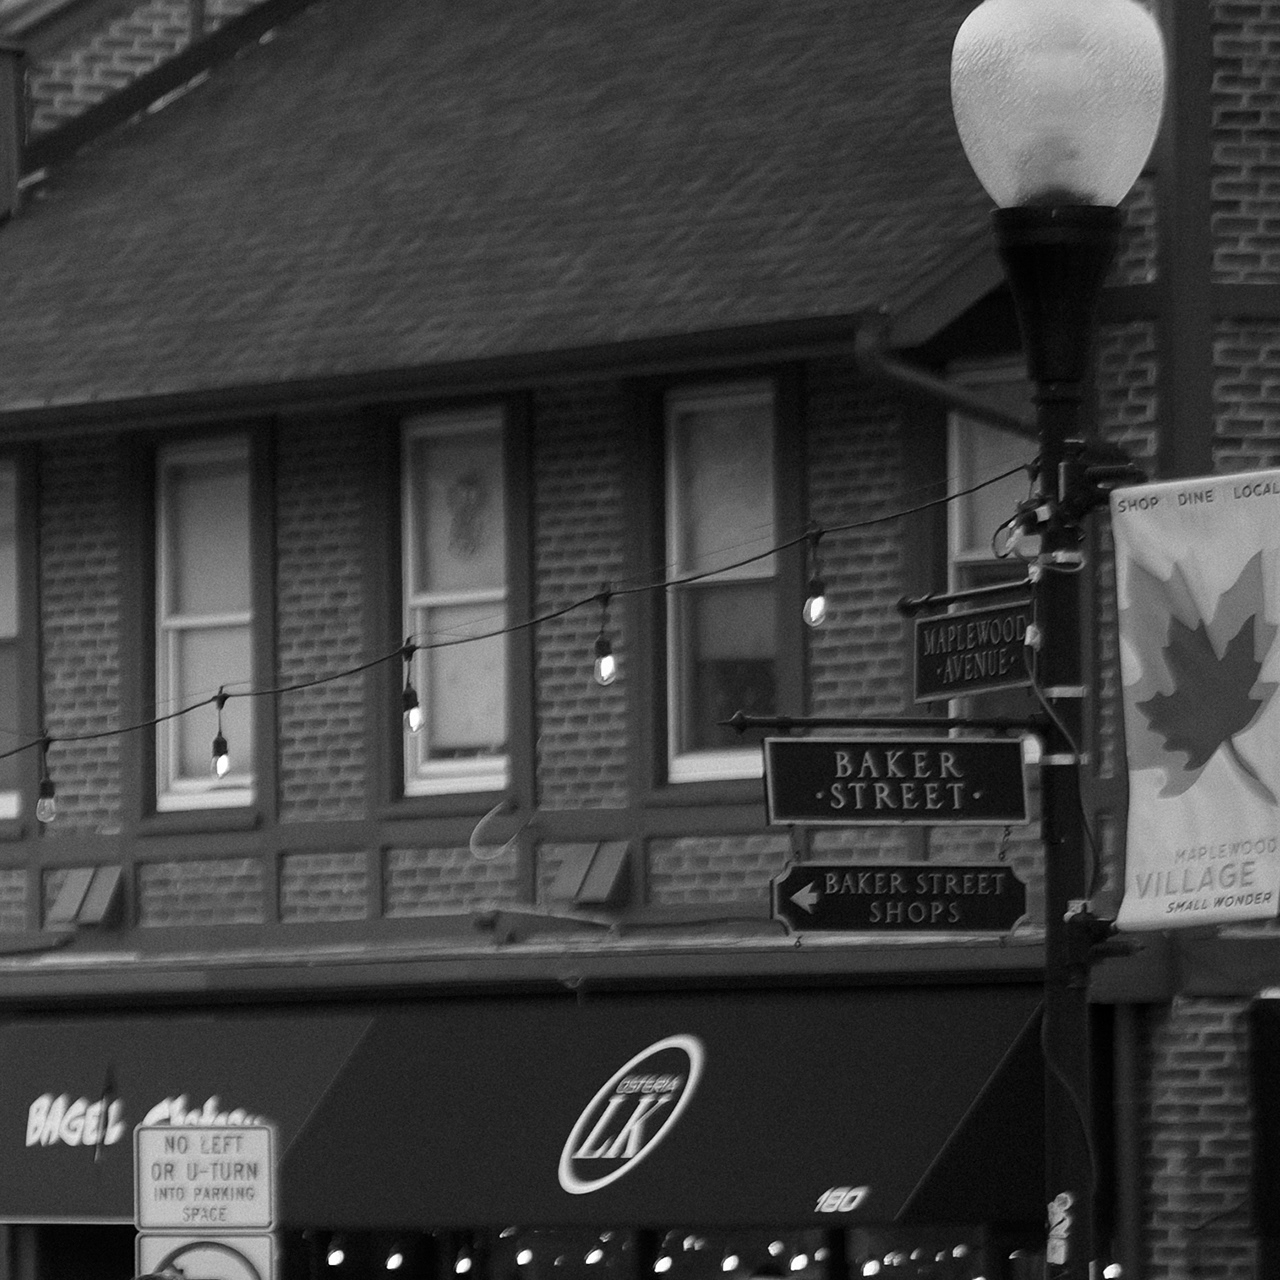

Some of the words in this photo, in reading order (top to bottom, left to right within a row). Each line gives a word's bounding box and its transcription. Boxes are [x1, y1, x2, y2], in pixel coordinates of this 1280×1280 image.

[1117, 496, 1159, 513] SHOP
[1177, 489, 1214, 506] DINE
[1233, 482, 1280, 500] LOCAL
[923, 614, 1026, 656] MAPLEWOOD
[942, 648, 1008, 684] AVENUE
[834, 751, 964, 778] BAKER
[830, 782, 965, 810] STREET
[1175, 838, 1277, 864] MAPLEWOOD
[824, 872, 908, 895] BAKER
[915, 872, 1006, 895] STREET
[1135, 861, 1256, 899] VILLAGE
[869, 901, 960, 923] SHOPS
[1165, 898, 1209, 914] SMALL
[1213, 891, 1273, 909] WONDER
[615, 1073, 681, 1094] OSTERIA
[25, 1093, 125, 1148] BAGEL
[164, 1135, 188, 1155] NO
[200, 1135, 245, 1155] LEFT
[151, 1162, 175, 1181] OR
[187, 1162, 258, 1181] U-TURN
[154, 1186, 185, 1201] INTO
[193, 1186, 256, 1201] PARKING
[182, 1206, 228, 1222] SPACE
